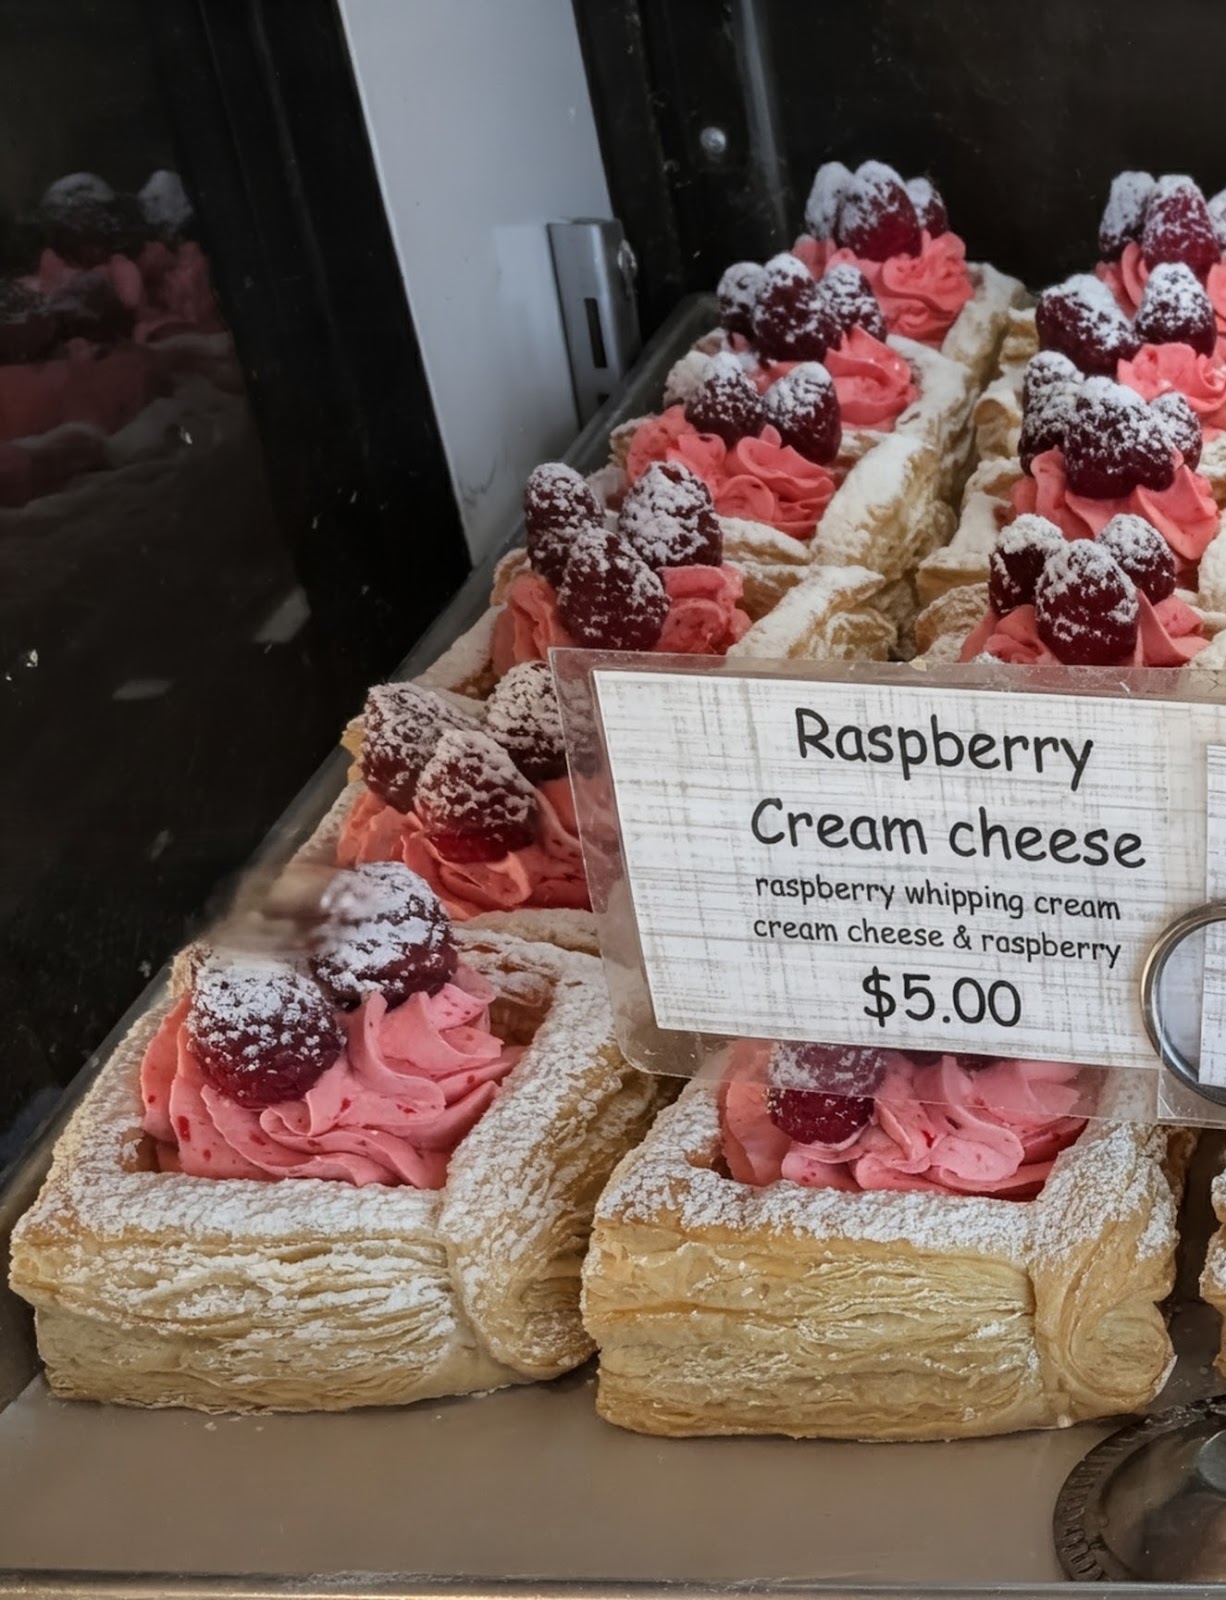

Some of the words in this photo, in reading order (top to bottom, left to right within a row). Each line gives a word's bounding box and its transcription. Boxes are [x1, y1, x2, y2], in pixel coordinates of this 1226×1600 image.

[795, 707, 1094, 792] Raspberry
[751, 798, 928, 855] Cream
[949, 806, 1146, 869] cheese
[755, 874, 895, 910] raspberry
[904, 879, 1024, 920] whipping
[1034, 896, 1121, 921] cream
[753, 919, 838, 942] cream
[847, 917, 944, 947] cheese
[953, 924, 972, 951] &
[981, 931, 1121, 969] raspberry
[862, 965, 1022, 1028] $5.00
